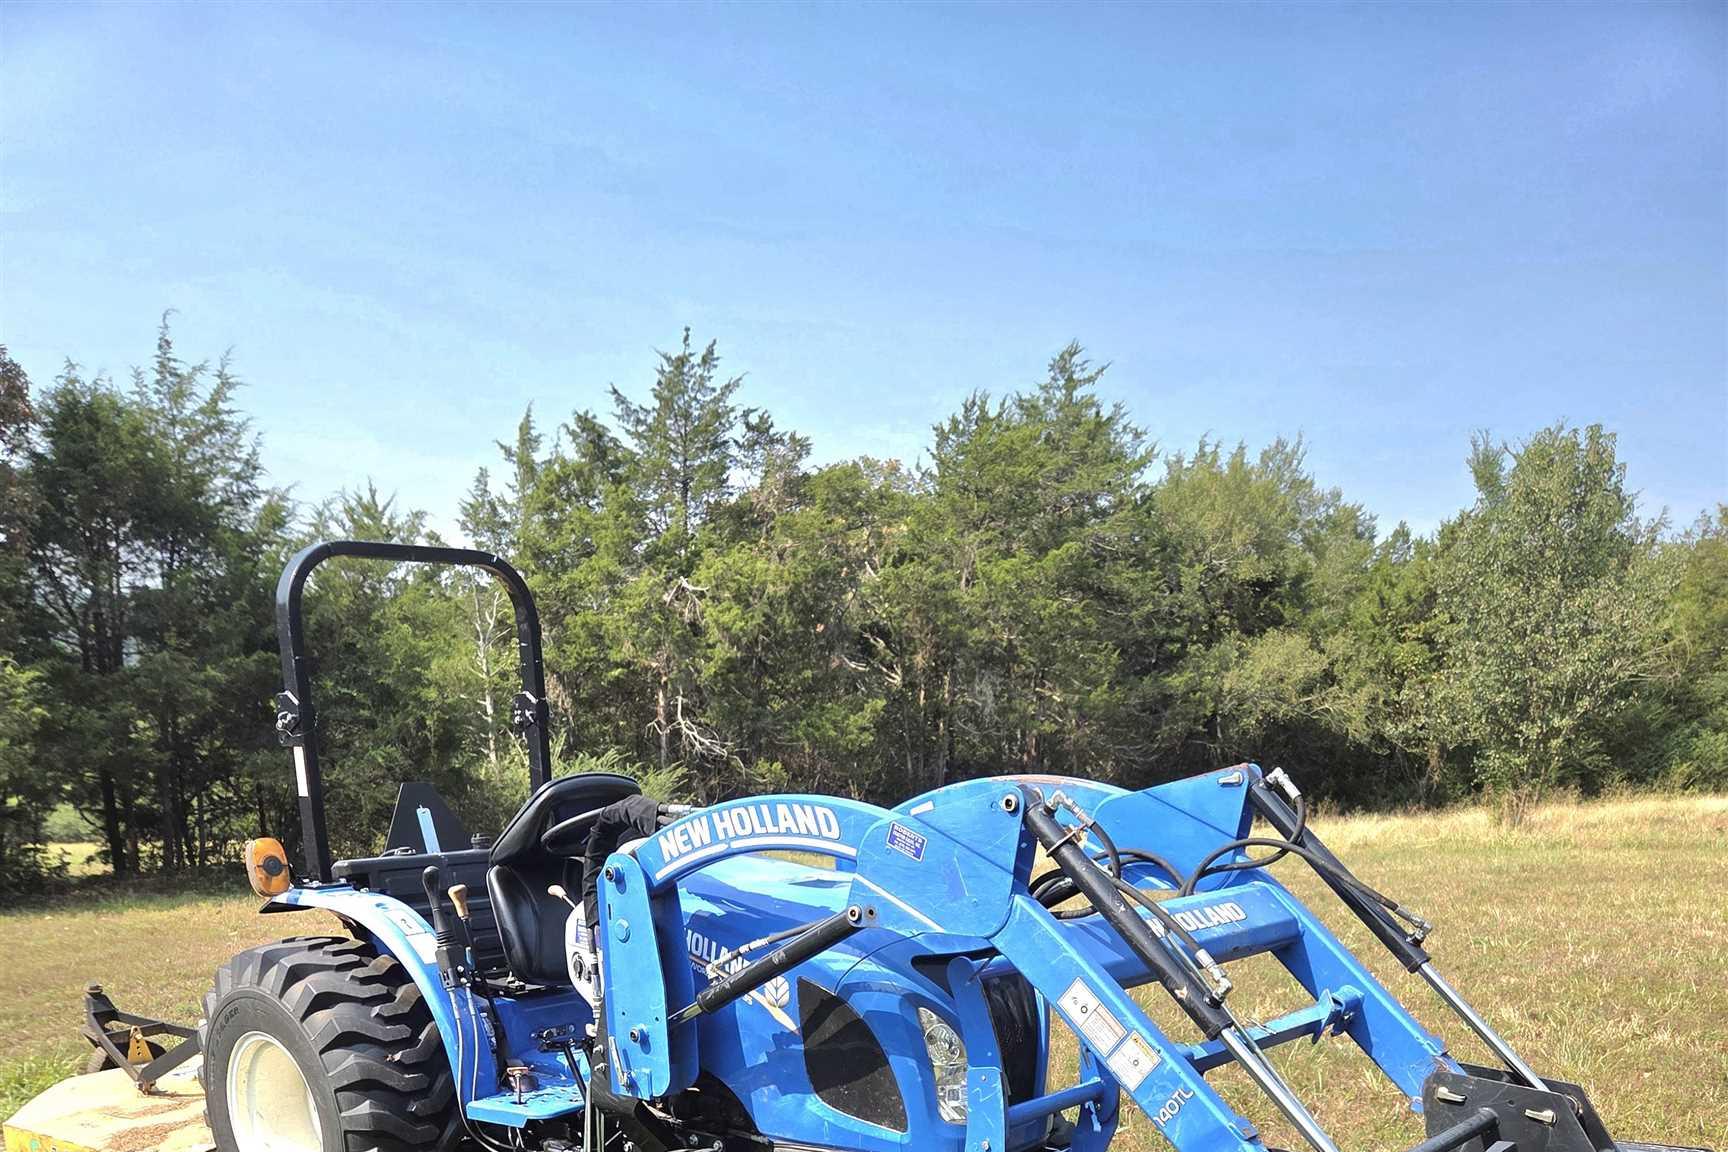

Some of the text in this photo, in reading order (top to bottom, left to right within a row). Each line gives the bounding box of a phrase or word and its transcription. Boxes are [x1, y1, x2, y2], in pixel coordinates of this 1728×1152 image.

[658, 803, 841, 863] NEW HOLLAND
[1170, 902, 1247, 932] OLLAND
